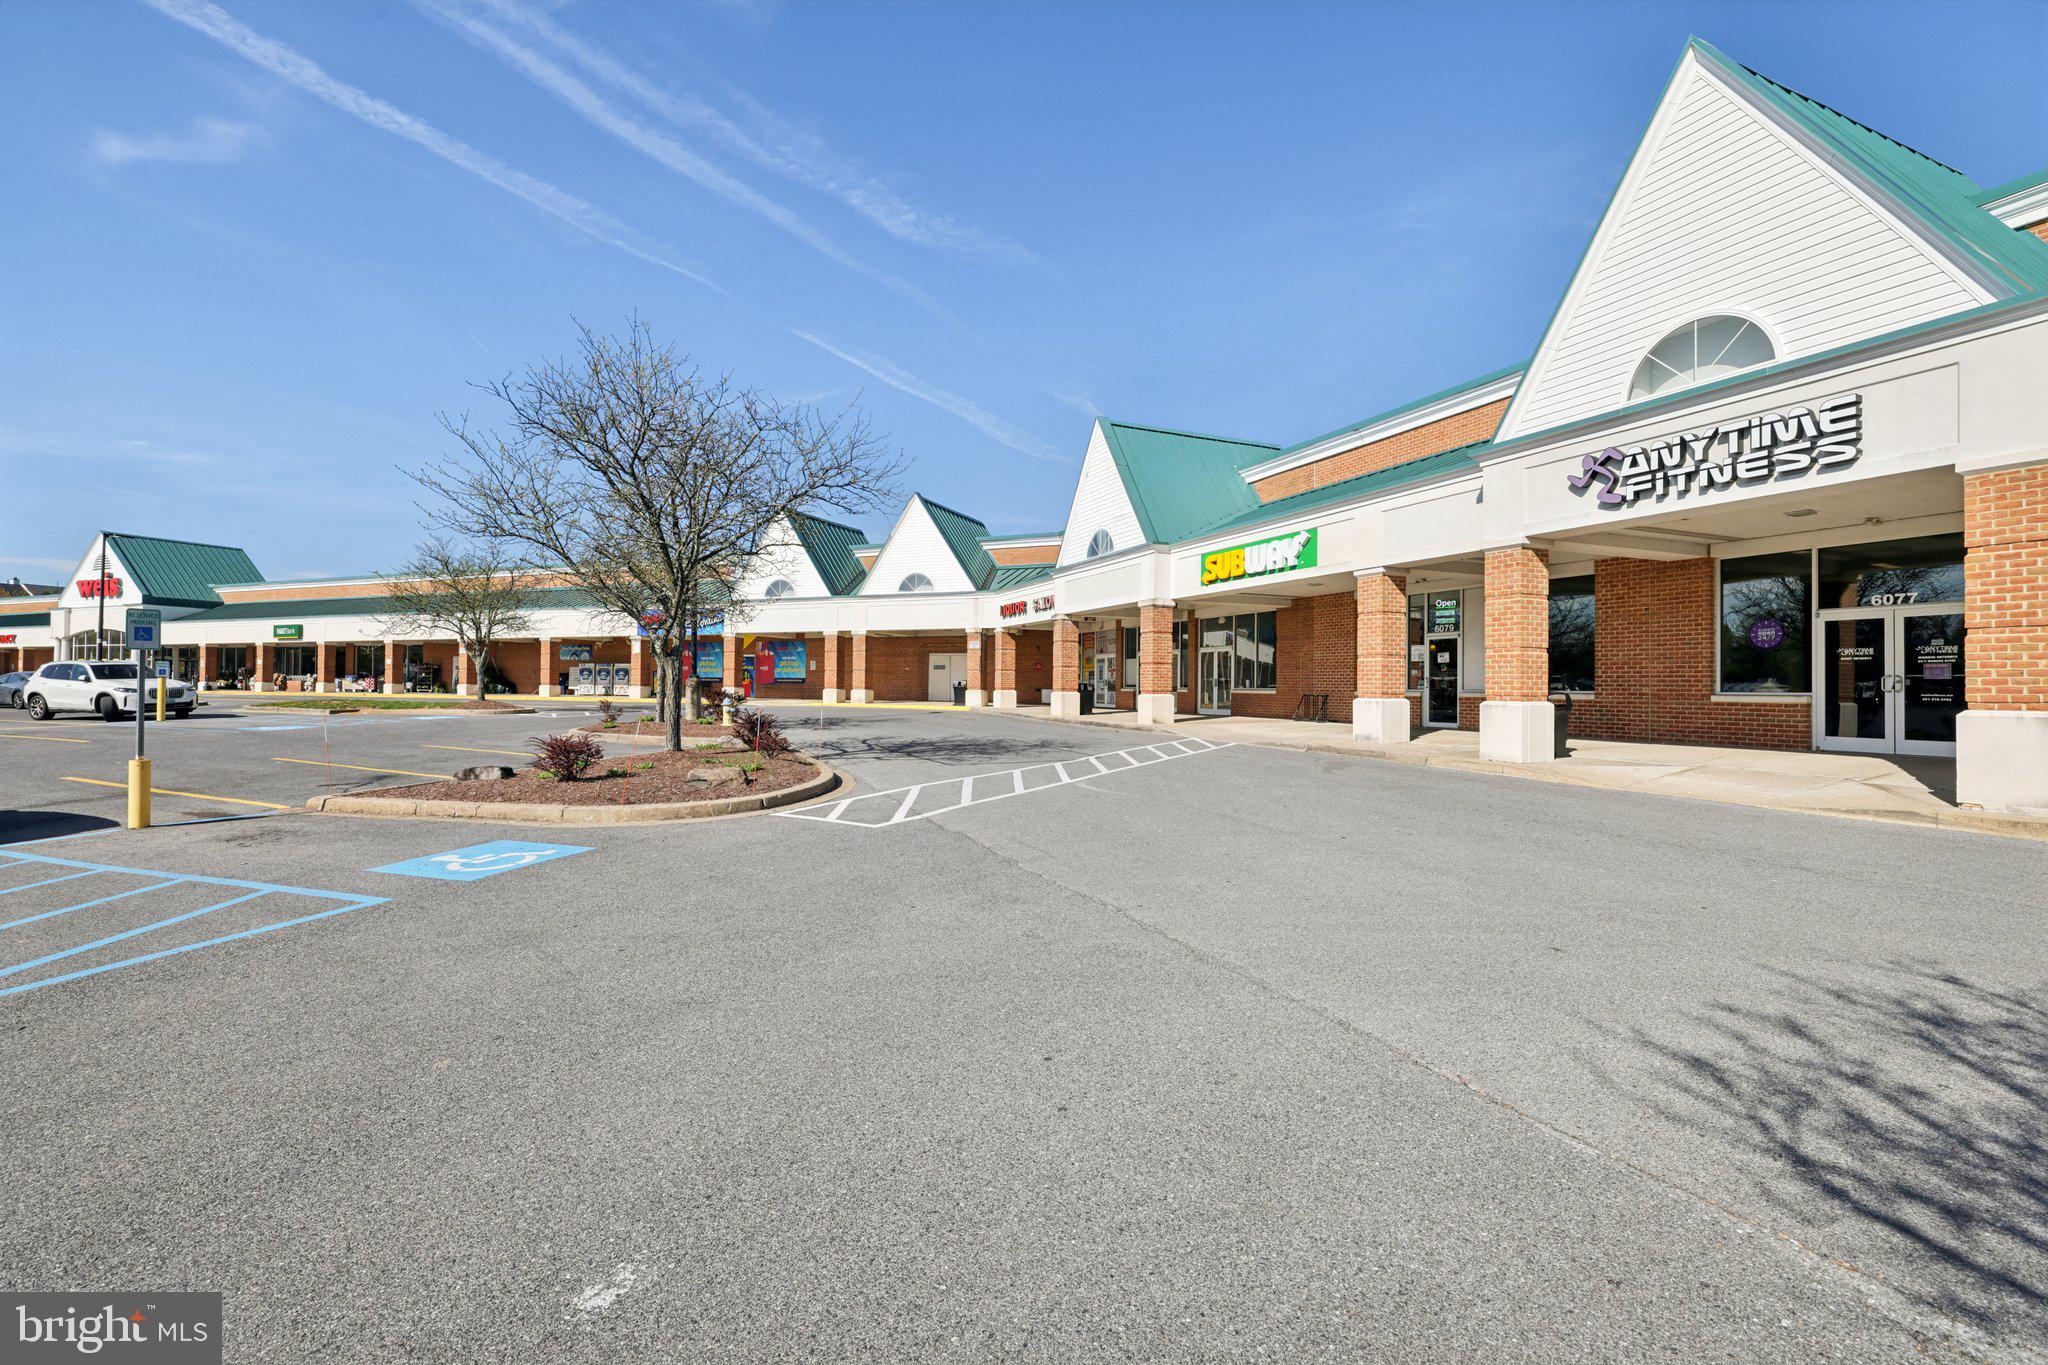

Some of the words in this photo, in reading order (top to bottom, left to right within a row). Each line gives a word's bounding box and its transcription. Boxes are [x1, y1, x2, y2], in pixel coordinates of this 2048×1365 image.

[1620, 393, 1861, 476] ANYTIME
[1626, 433, 1861, 502] FITNESS
[1202, 531, 1311, 584] SUBWAY
[1435, 599, 1457, 608] Open
[1870, 592, 1919, 606] 6077
[128, 611, 159, 619] RESERVED
[1000, 601, 1027, 617] LIQUOR
[1434, 624, 1455, 632] 6079
